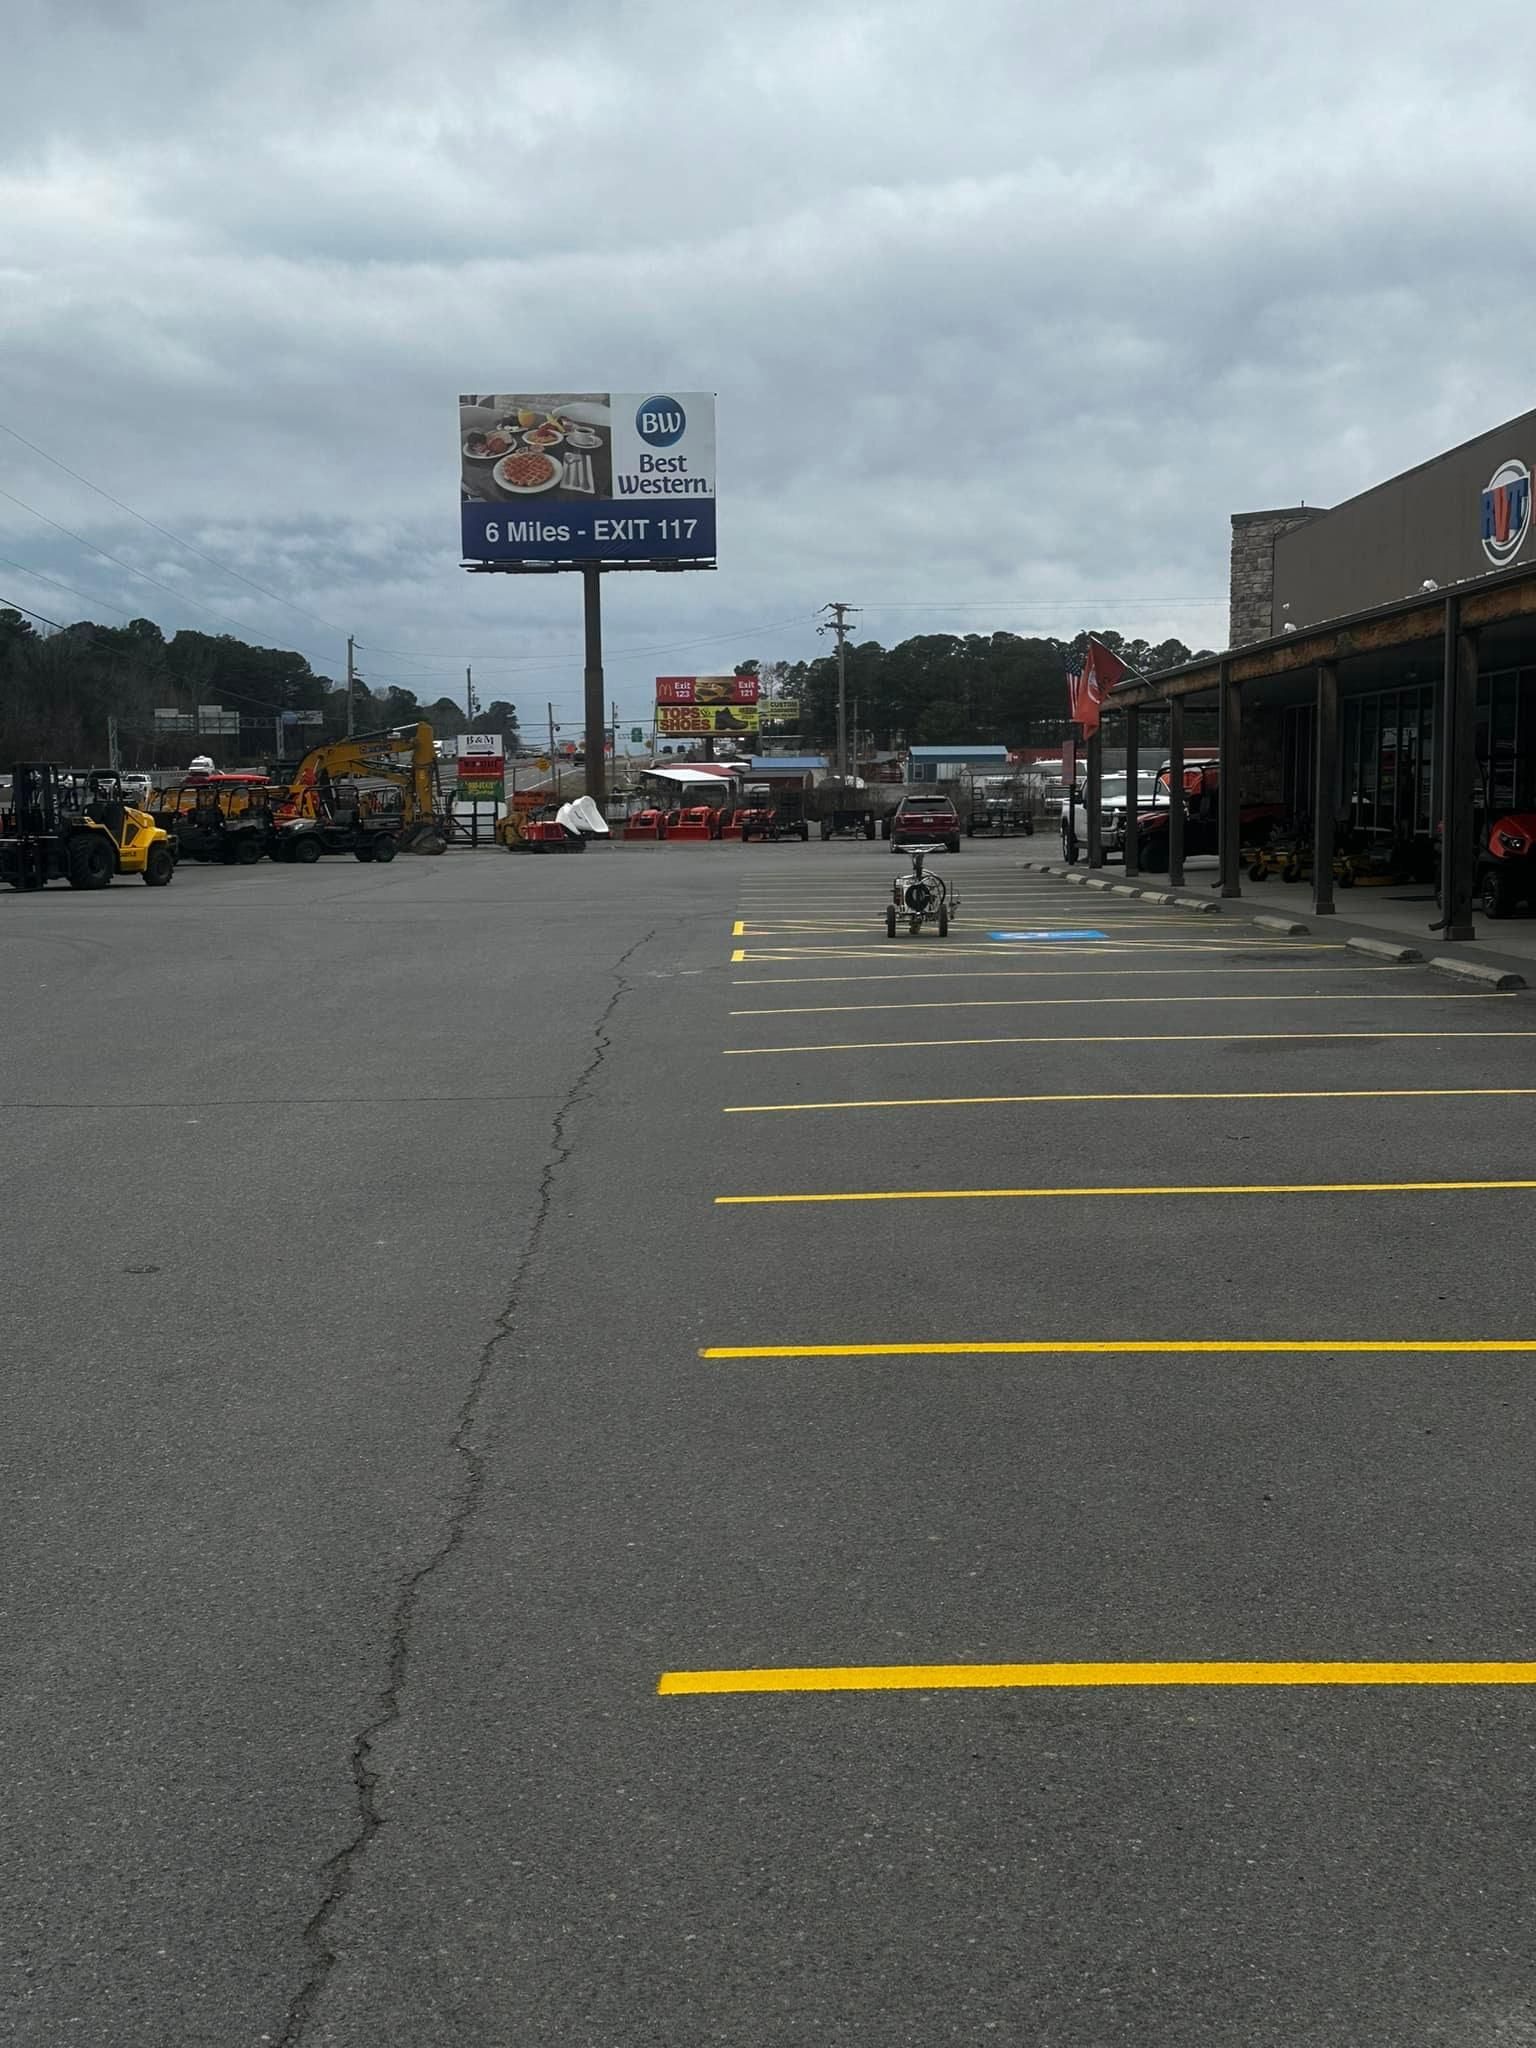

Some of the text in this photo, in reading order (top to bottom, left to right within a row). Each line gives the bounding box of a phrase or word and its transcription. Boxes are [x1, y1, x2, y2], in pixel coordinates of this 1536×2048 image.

[642, 412, 681, 433] BW
[639, 454, 688, 473] Best
[485, 522, 499, 542] 6
[507, 521, 570, 542] Miles
[594, 519, 649, 541] EXIT
[657, 518, 698, 540] 117
[674, 681, 691, 690] Exit
[738, 680, 755, 689] Exit
[675, 690, 690, 698] 123
[740, 689, 754, 697] 121
[660, 707, 700, 719] TOPS
[660, 719, 711, 731] SHOES
